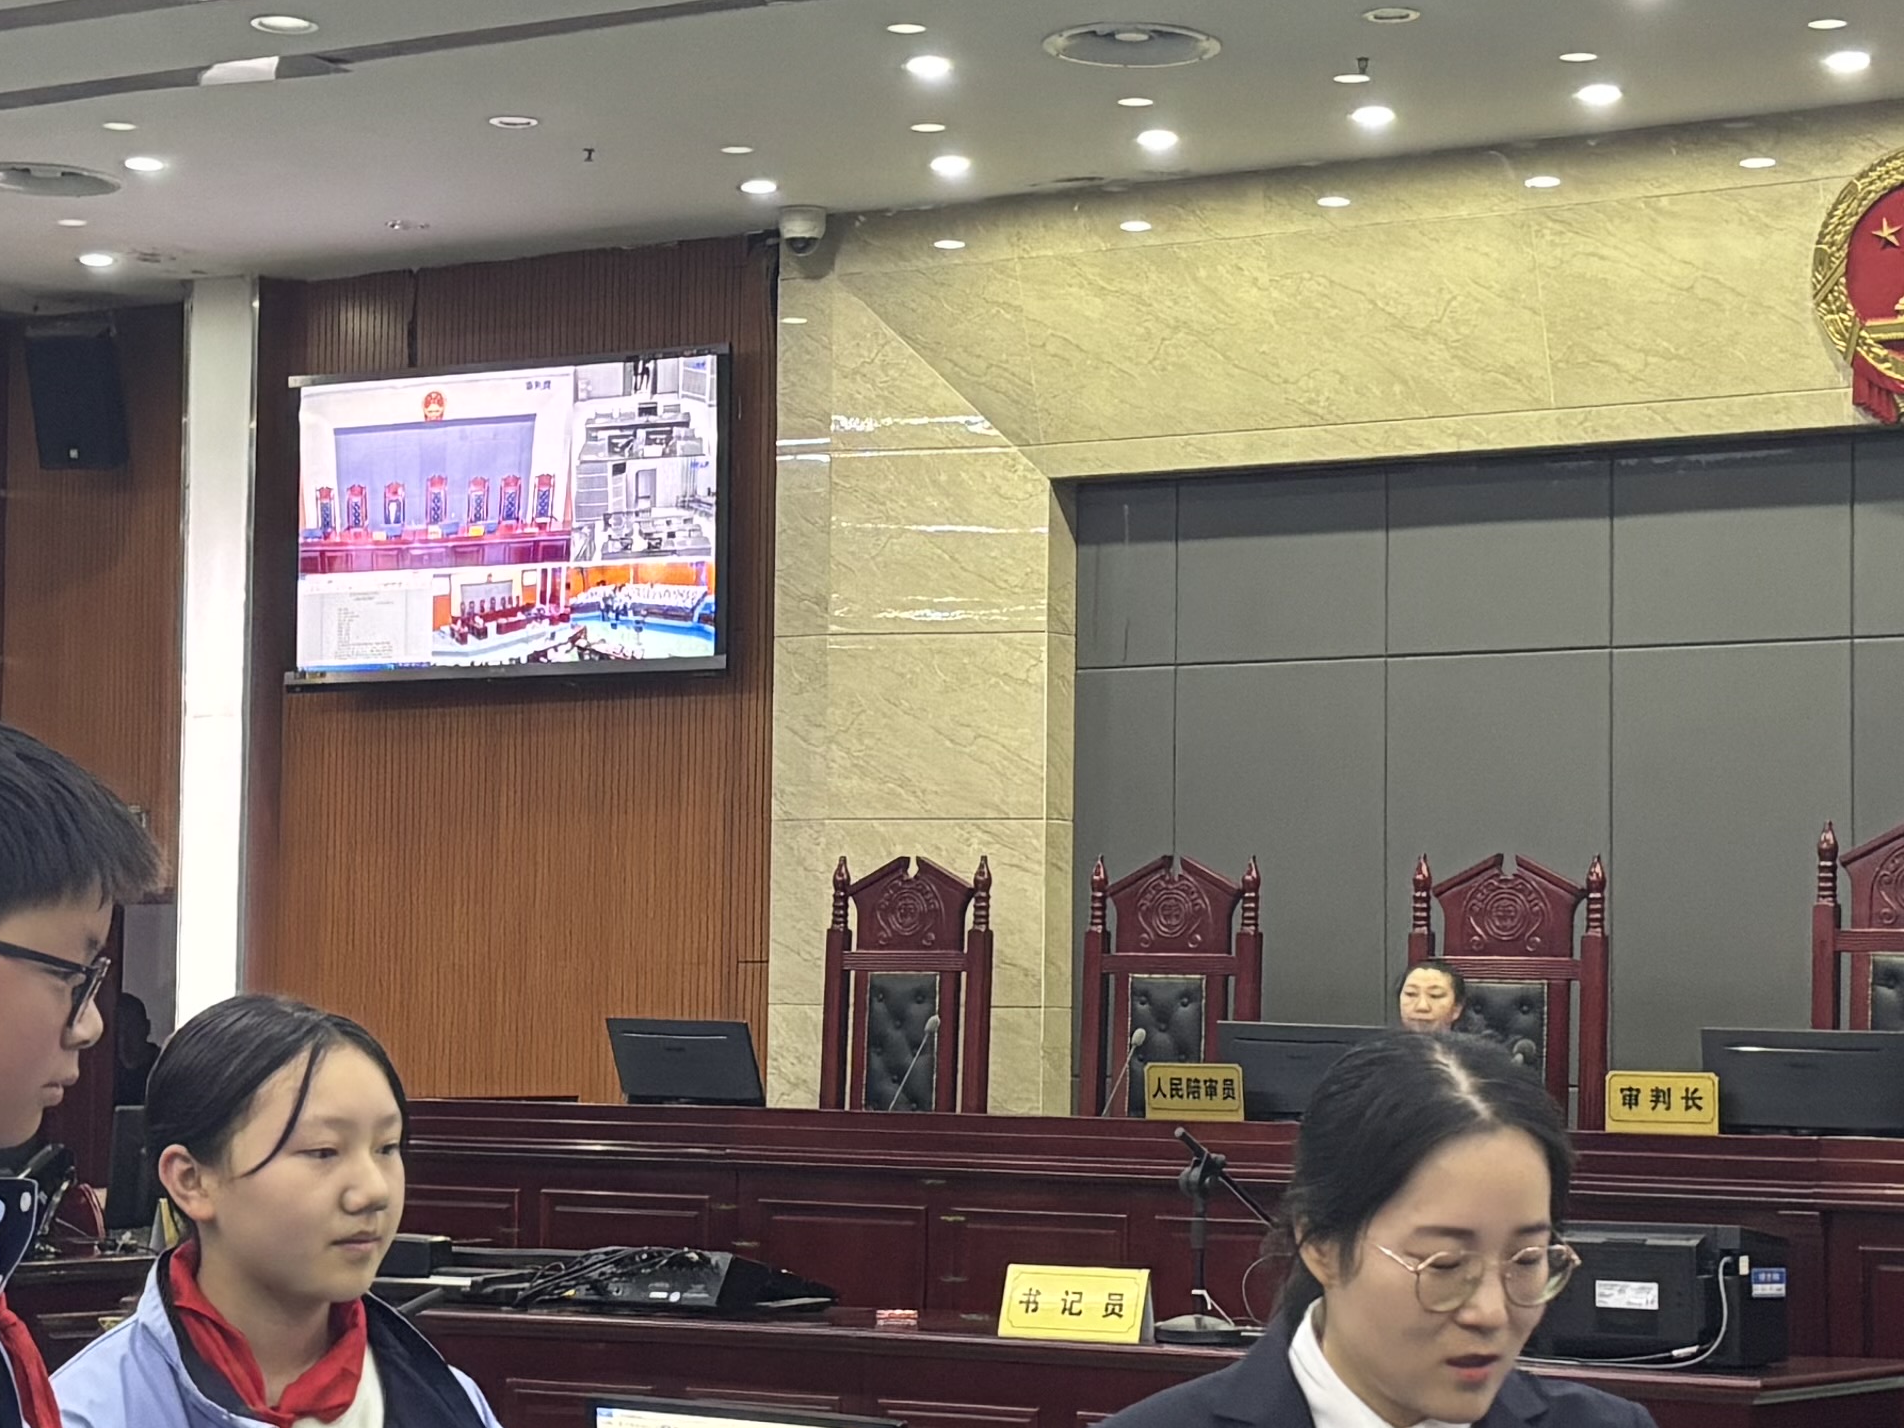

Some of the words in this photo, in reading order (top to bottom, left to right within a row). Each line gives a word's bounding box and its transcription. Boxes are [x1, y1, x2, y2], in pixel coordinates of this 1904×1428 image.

[1152, 1076, 1236, 1101] 人民陪审员
[1619, 1085, 1704, 1112] 审判长
[1018, 1287, 1125, 1319] 书记员
